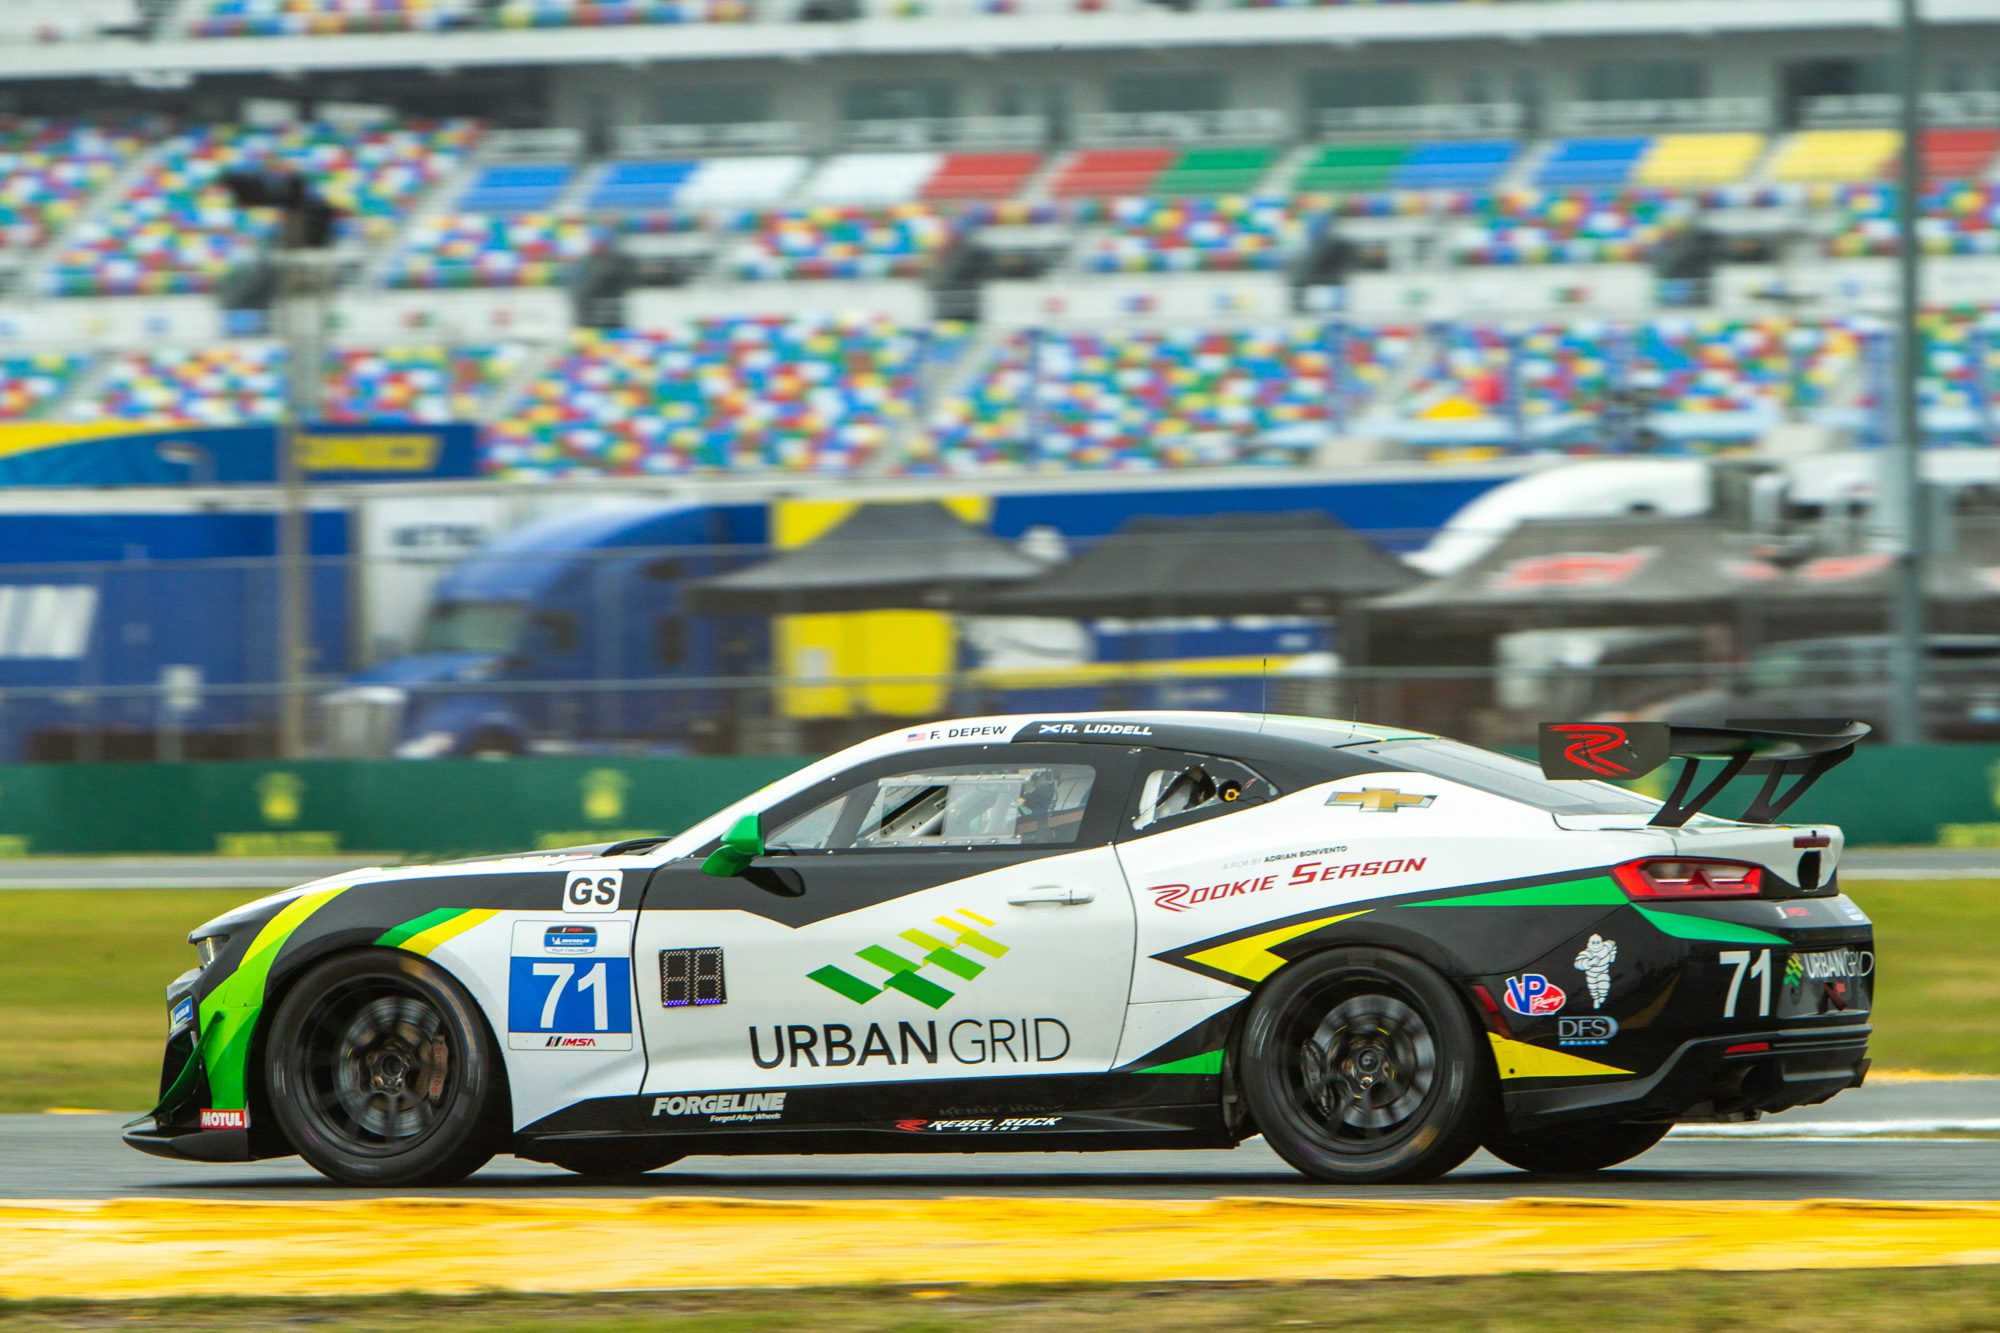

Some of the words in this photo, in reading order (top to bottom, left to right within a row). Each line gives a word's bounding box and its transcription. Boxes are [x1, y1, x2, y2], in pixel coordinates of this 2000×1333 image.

[930, 730, 941, 740] F.
[948, 725, 1007, 738] DEPEW
[1060, 723, 1078, 734] R.
[1083, 724, 1153, 736] LIDDELL
[1264, 852, 1297, 863] ADRIAN
[1299, 845, 1348, 858] BONVENTO
[1287, 856, 1428, 887] SEASON
[569, 877, 617, 906] GS
[1719, 948, 1772, 1019] 71
[532, 962, 608, 1031] 71
[1505, 973, 1548, 1015] VP
[1558, 1019, 1608, 1038] DFS
[561, 1038, 596, 1048] IMSA
[652, 1092, 787, 1117] FORGELINE
[201, 1112, 243, 1126] MOTUL
[710, 1114, 736, 1124] Forged
[736, 1113, 755, 1123] Alloy
[754, 1112, 782, 1121] Wheels
[928, 1118, 995, 1131] REBEL
[999, 1117, 1063, 1127] ROCK
